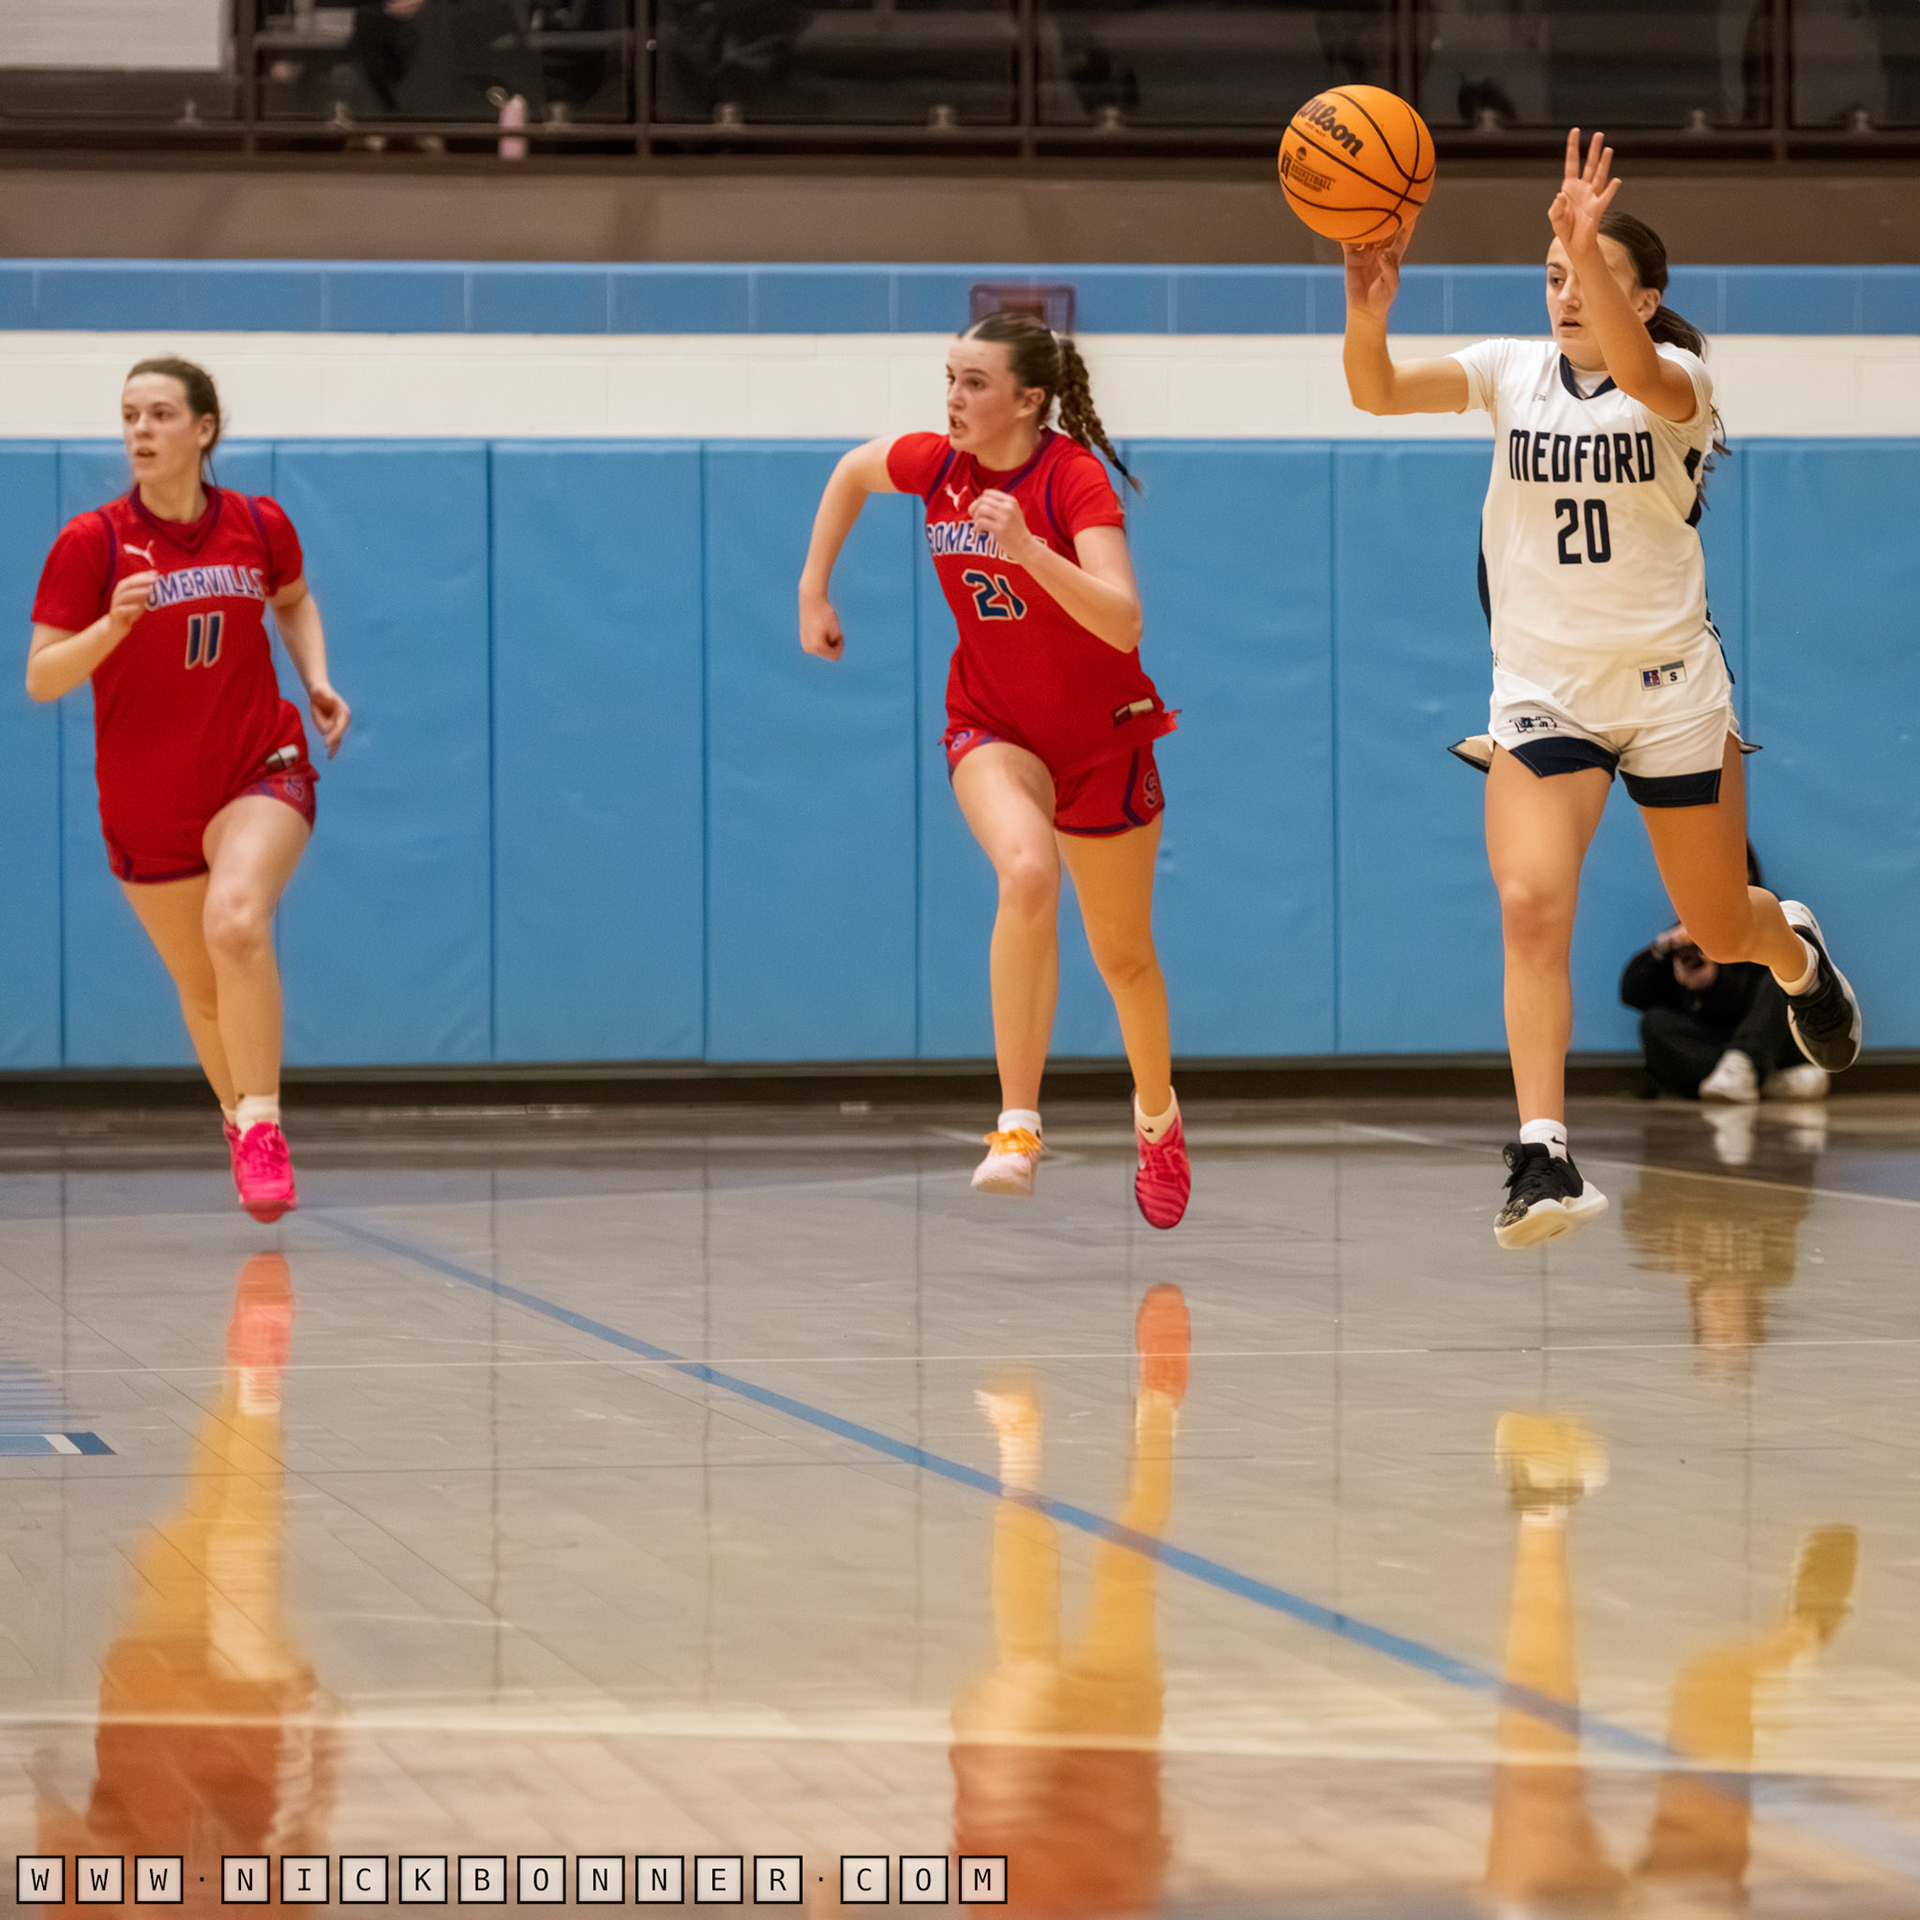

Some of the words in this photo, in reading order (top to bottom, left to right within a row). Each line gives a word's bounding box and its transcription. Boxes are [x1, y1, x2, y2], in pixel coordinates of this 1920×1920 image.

[1509, 429, 1655, 483] MEDFORD
[1555, 498, 1611, 564] 20
[961, 568, 1027, 621] 21
[184, 610, 224, 670] 11
[1669, 671, 1678, 681] S
